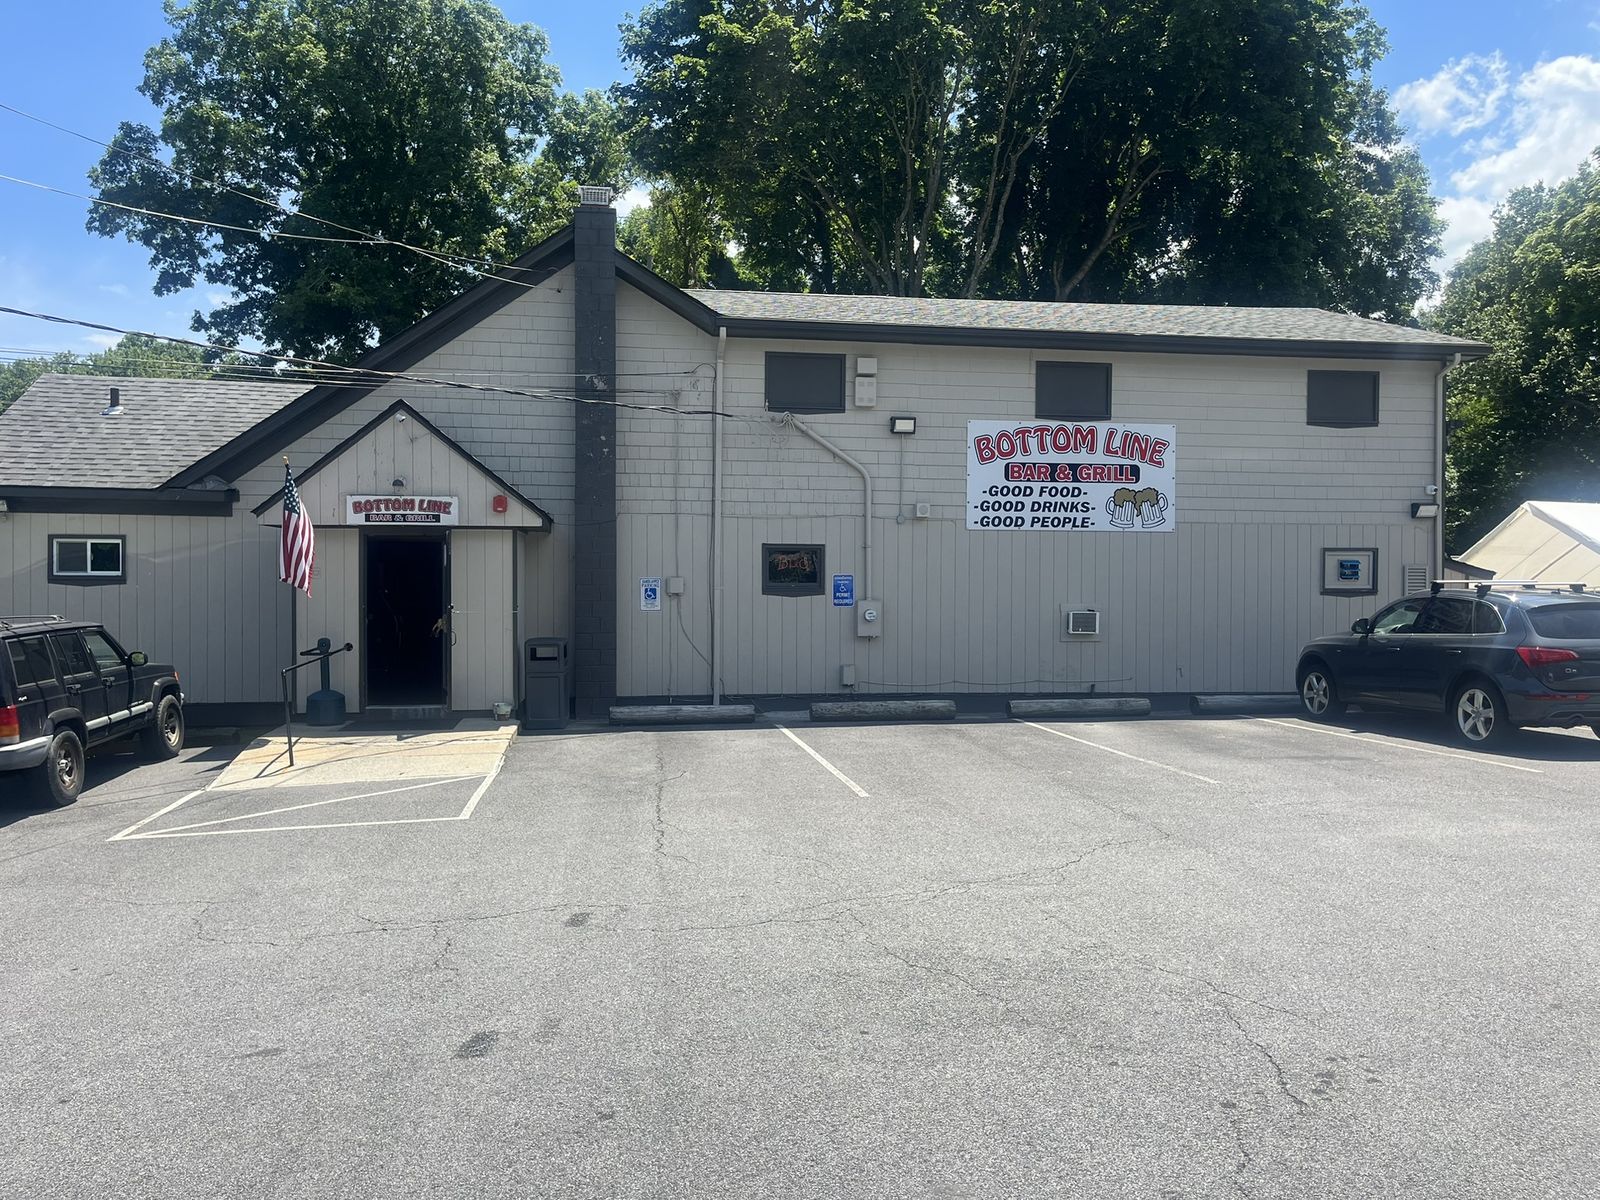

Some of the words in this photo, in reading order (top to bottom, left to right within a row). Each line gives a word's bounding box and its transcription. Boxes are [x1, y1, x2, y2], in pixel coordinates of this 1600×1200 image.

[974, 424, 1098, 465] BOTTOM
[1103, 428, 1170, 468] LINE
[1009, 464, 1050, 481] BAR
[1055, 465, 1072, 482] &
[1077, 465, 1136, 483] GRILL
[352, 498, 416, 515] BOTTOM
[418, 499, 453, 515] LINE
